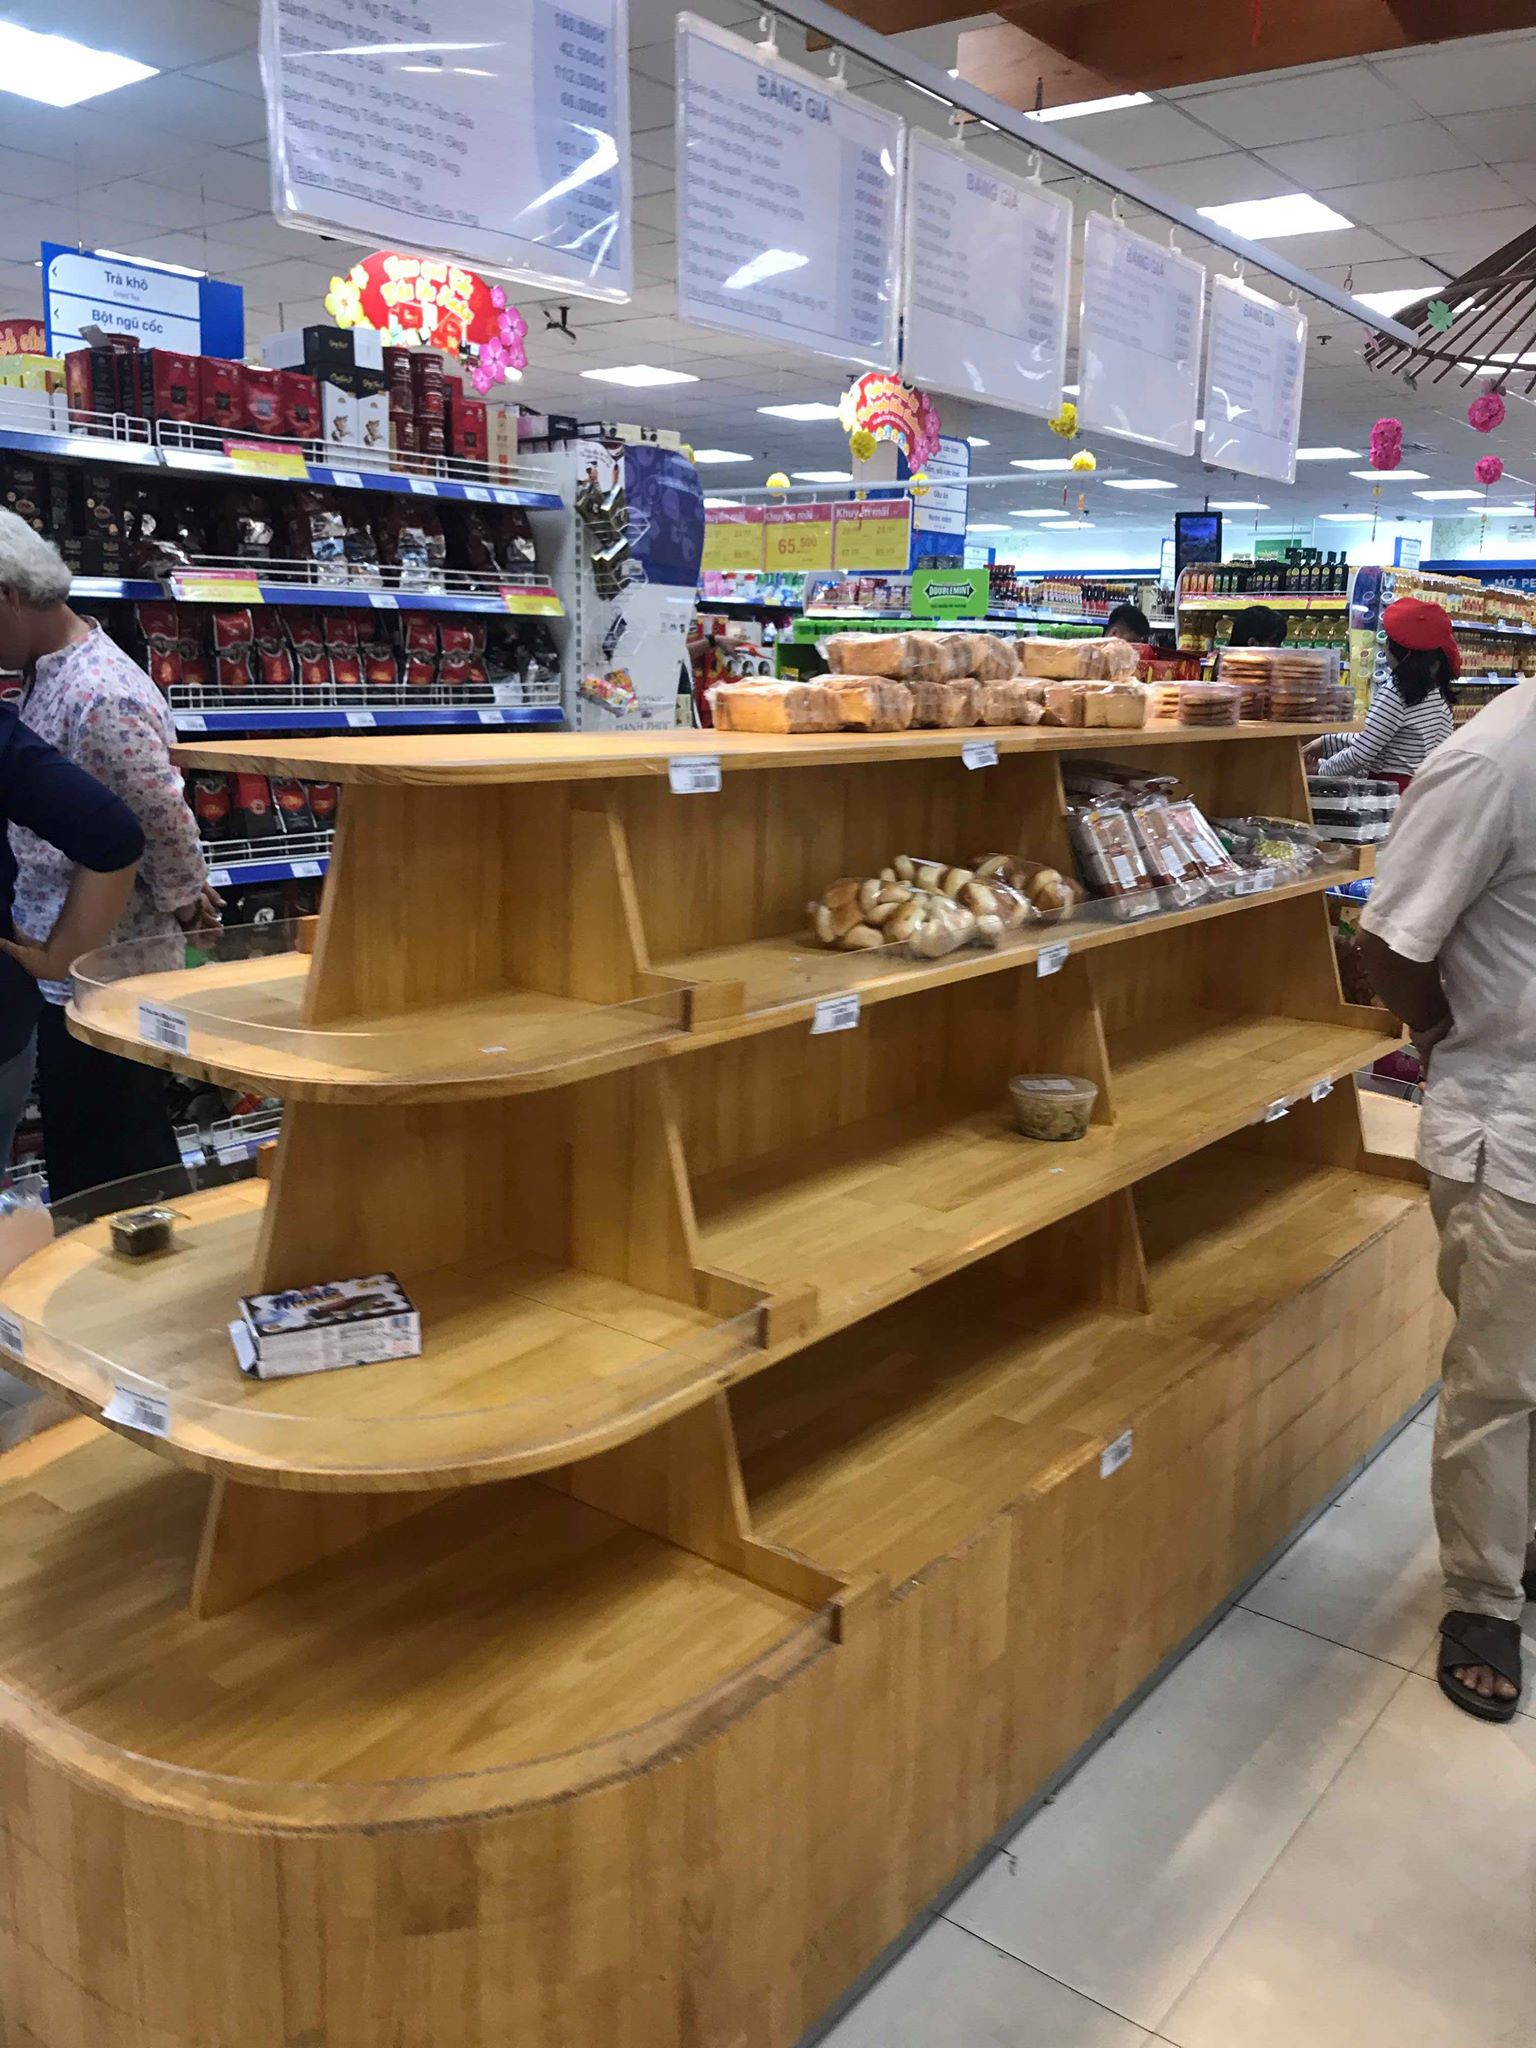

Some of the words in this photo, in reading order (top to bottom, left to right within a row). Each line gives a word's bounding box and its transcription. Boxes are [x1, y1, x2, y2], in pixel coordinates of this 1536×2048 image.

[104, 270, 124, 286] Trà
[126, 277, 149, 291] khô
[91, 309, 113, 326] Bột
[116, 315, 140, 330] ngũ
[142, 317, 164, 334] cốc
[1494, 575, 1517, 588] MỞ
[928, 585, 970, 596] DOUBLEMINT
